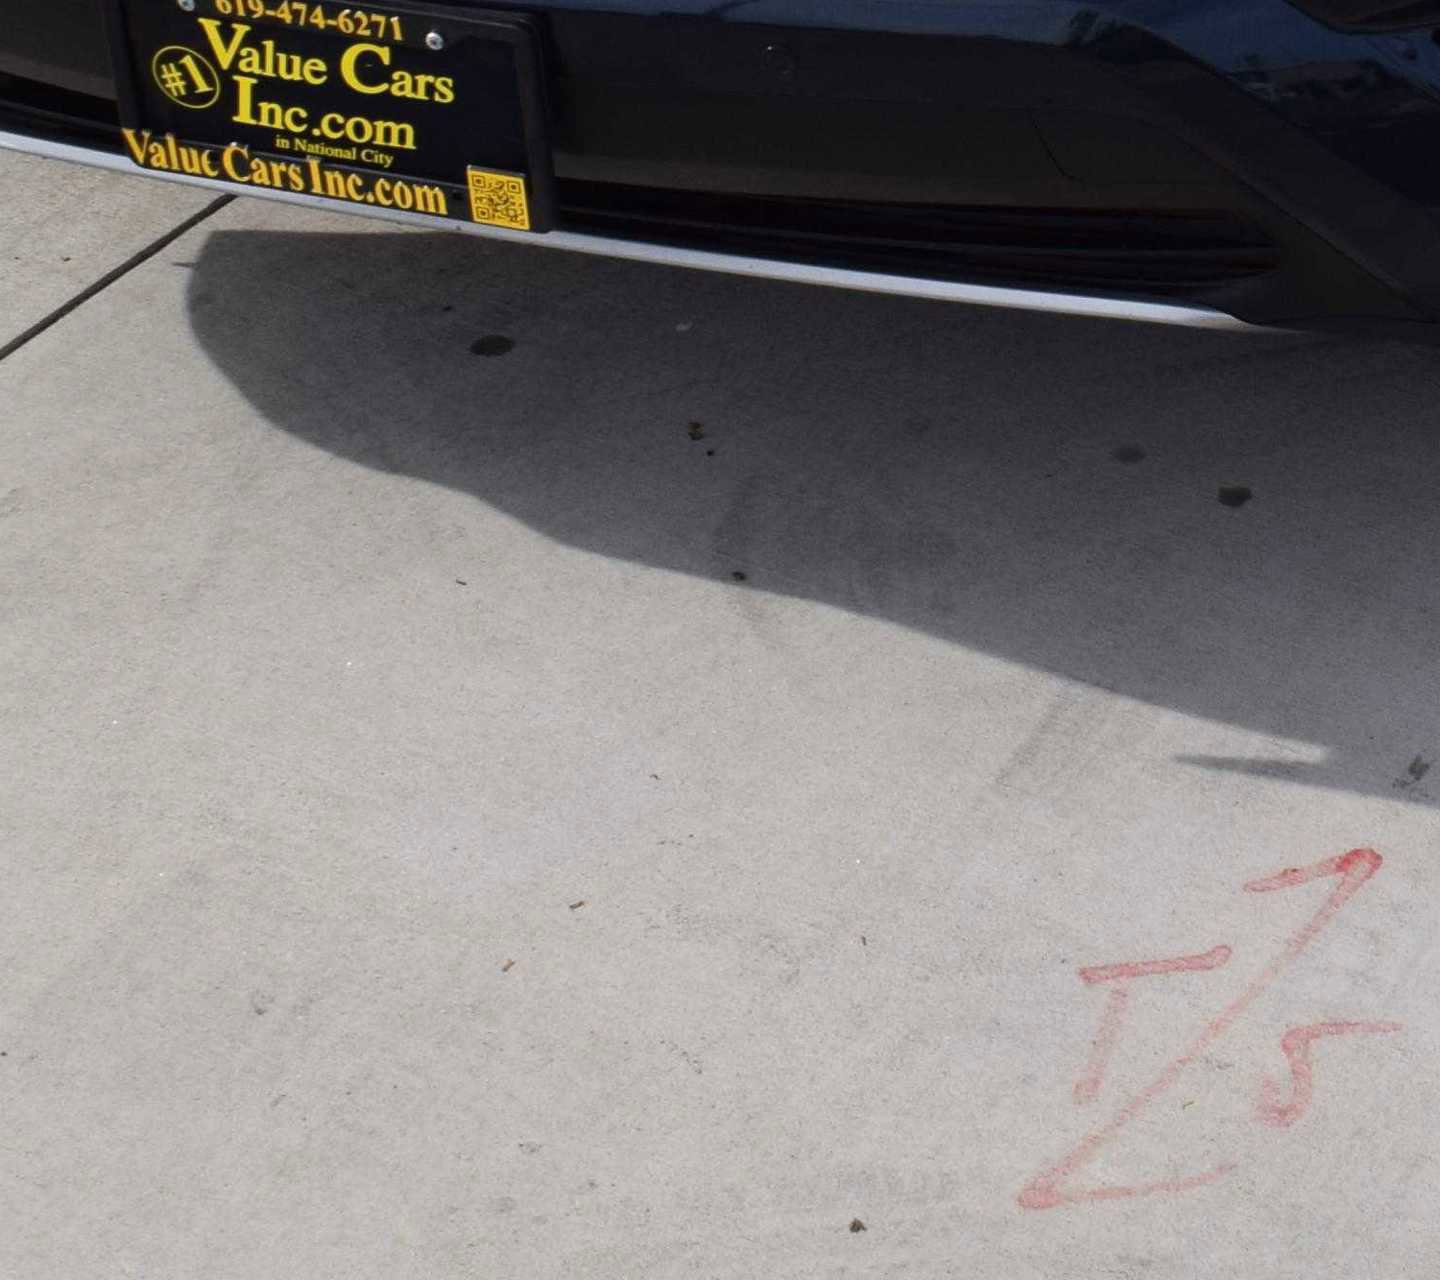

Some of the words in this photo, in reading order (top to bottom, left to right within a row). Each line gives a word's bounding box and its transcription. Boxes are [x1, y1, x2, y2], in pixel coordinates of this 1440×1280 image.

[160, 53, 211, 97] #1
[198, 17, 328, 86] Value
[340, 42, 456, 105] Cars
[233, 75, 417, 151] Inc.com
[275, 134, 290, 149] in
[293, 139, 357, 162] National
[361, 148, 395, 168] City
